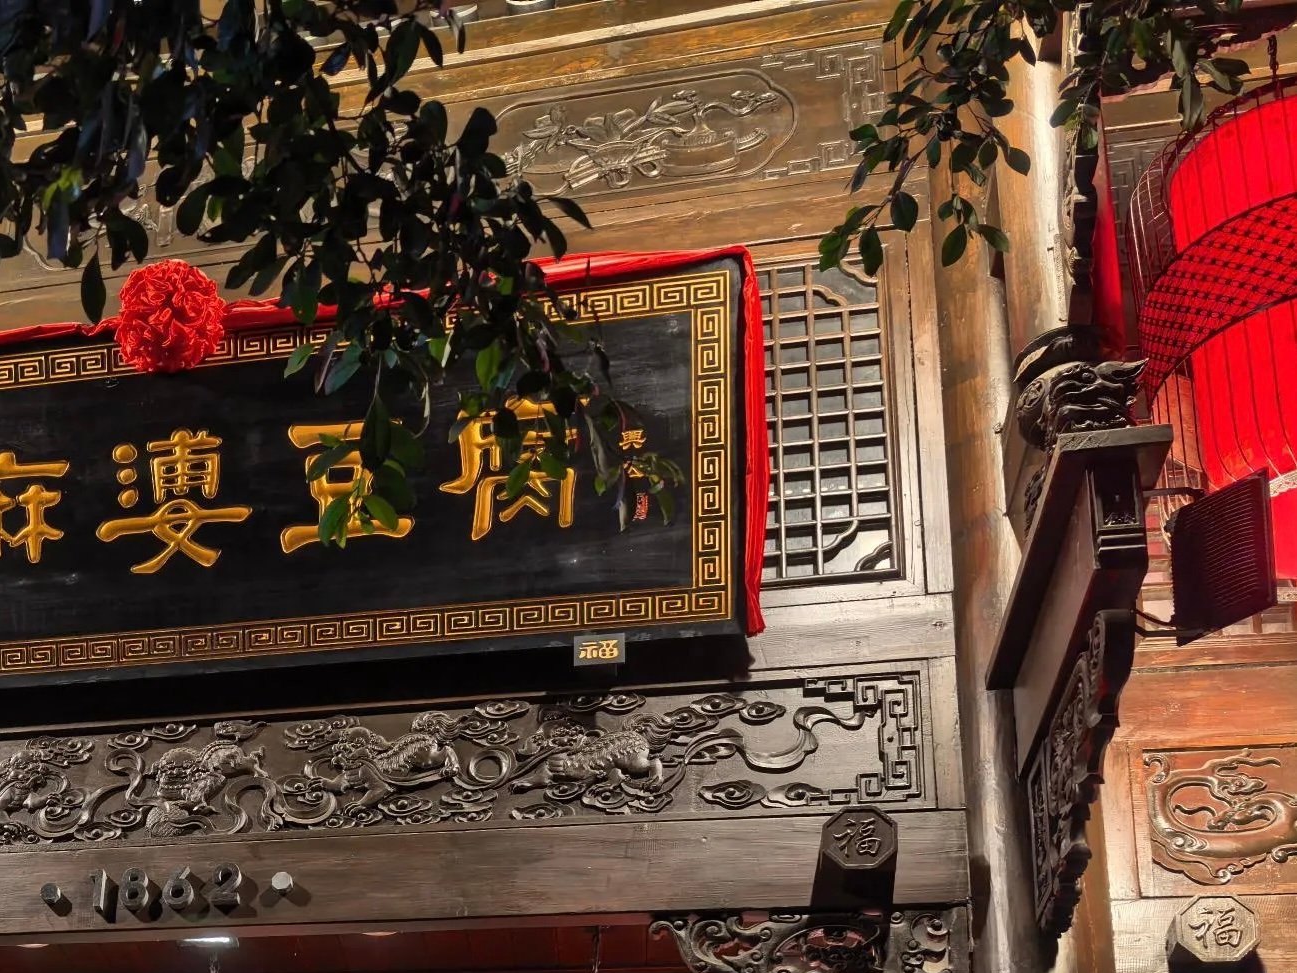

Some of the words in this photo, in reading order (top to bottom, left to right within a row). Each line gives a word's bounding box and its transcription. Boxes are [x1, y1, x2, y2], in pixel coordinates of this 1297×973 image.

[833, 817, 882, 858] 福
[89, 862, 243, 911] 1862
[1187, 907, 1244, 950] 福
